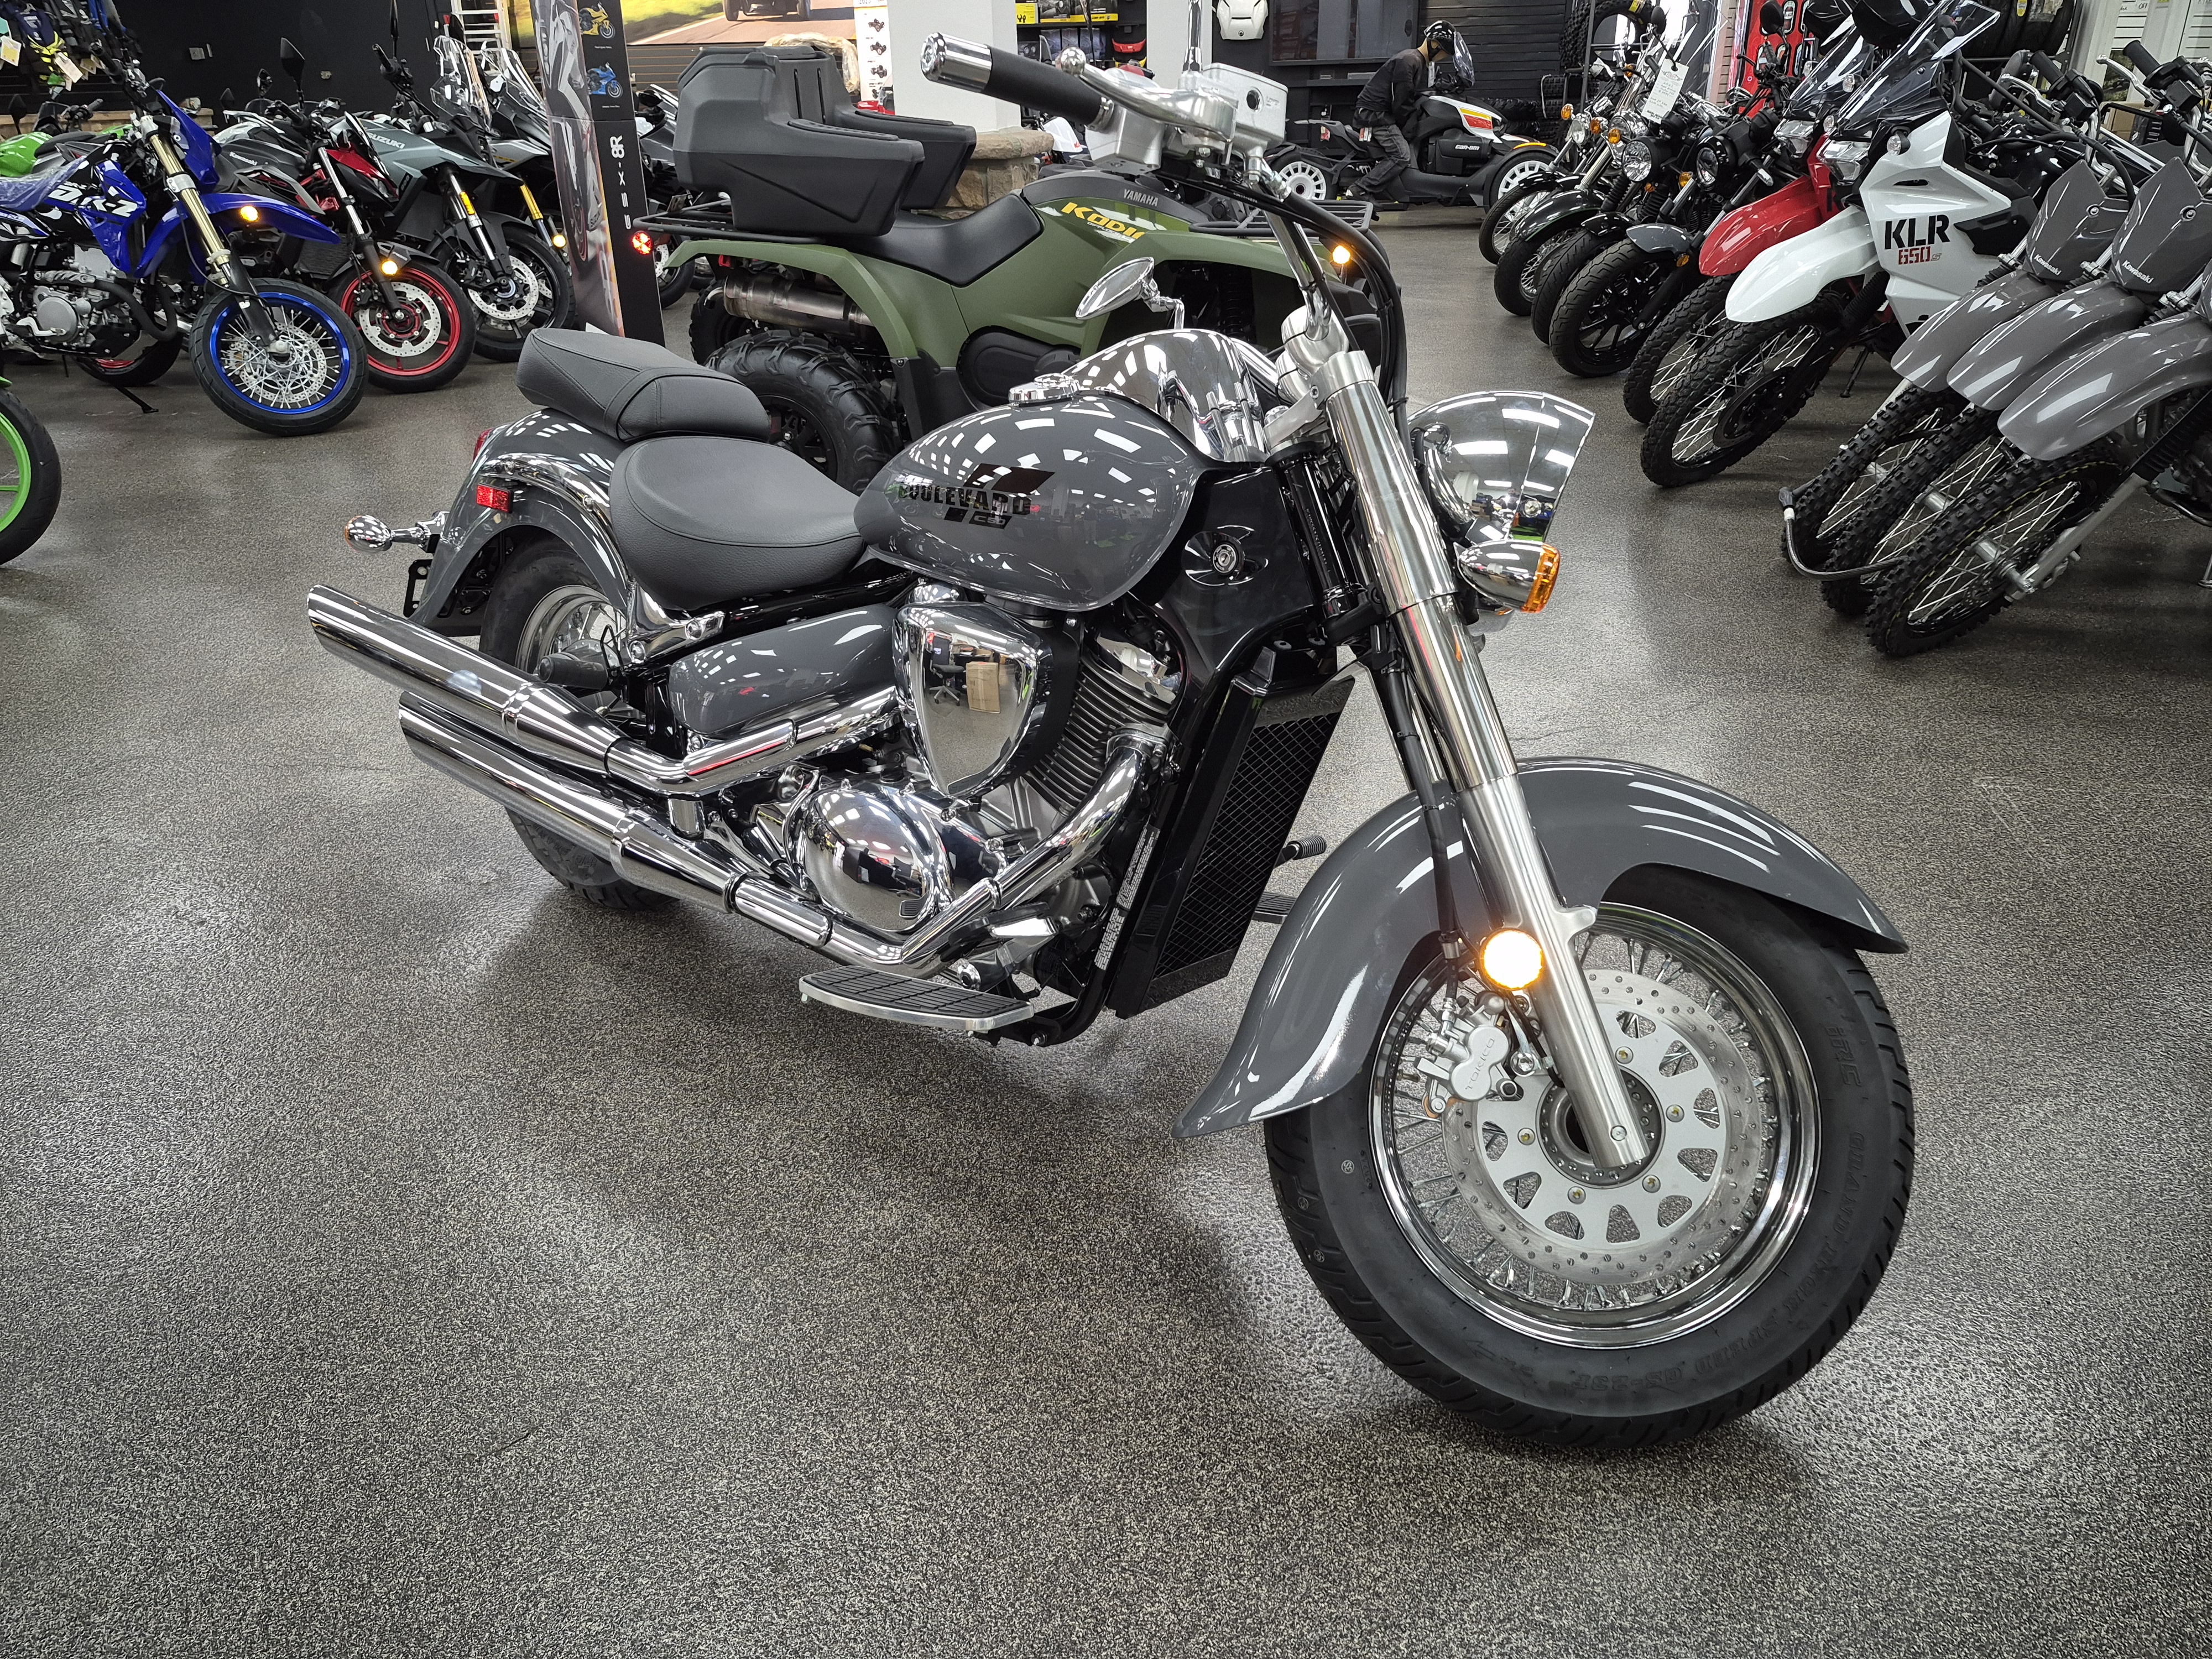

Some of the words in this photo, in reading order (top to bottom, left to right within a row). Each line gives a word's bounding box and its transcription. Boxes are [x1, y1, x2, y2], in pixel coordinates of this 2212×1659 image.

[366, 132, 405, 149] SUZUKI
[229, 151, 258, 166] Kawasaki
[1123, 189, 1159, 207] YAMAHA
[1884, 214, 1950, 250] KLR
[2033, 254, 2062, 276] Kawasaki
[2122, 260, 2154, 284] Kawasaki
[898, 484, 1032, 515] BOULEVARD
[1465, 1037, 1495, 1091] TOKICO
